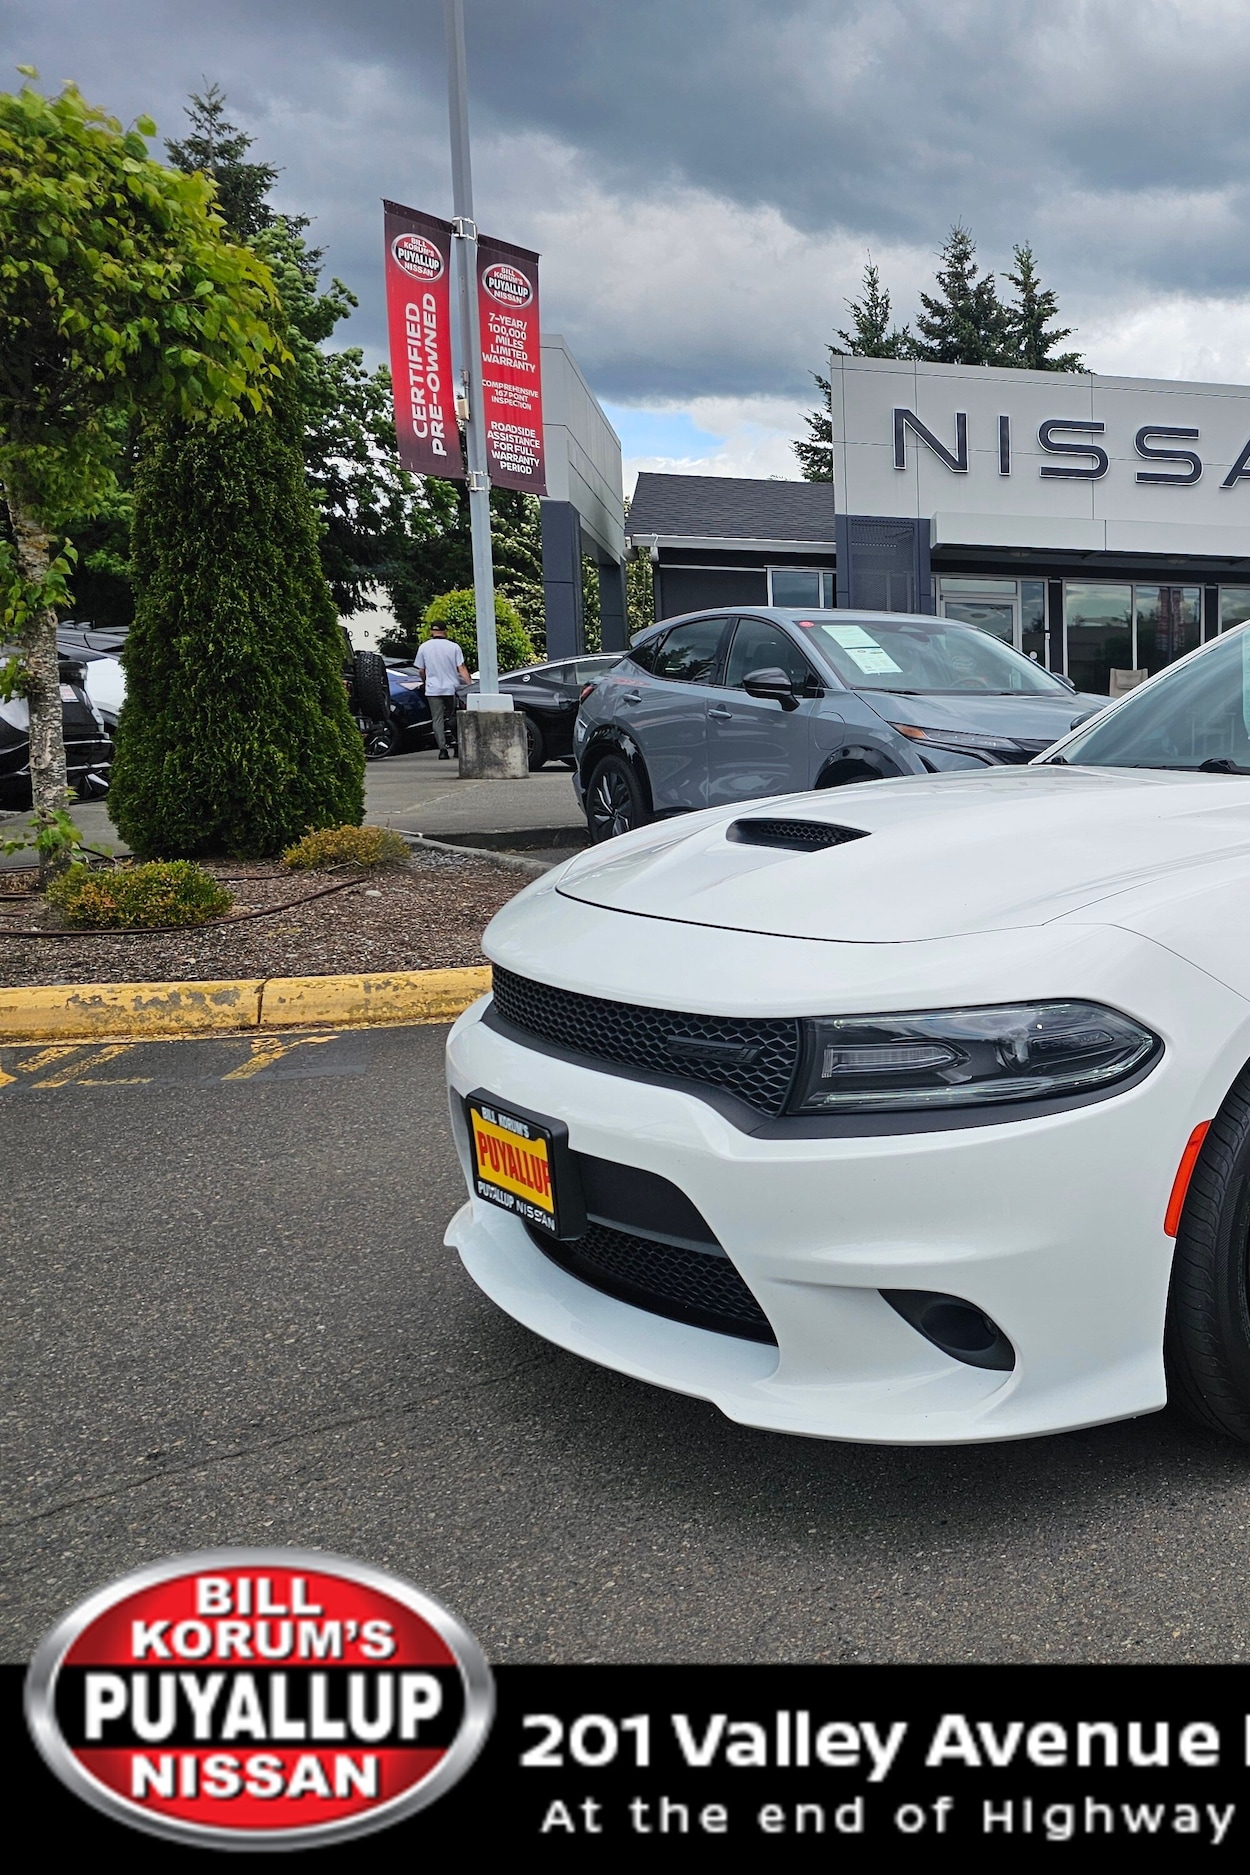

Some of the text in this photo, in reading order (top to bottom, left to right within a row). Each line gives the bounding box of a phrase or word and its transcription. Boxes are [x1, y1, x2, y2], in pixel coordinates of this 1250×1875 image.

[404, 241, 435, 257] KORUM'S
[411, 237, 427, 248] BILL
[398, 247, 440, 270] PUYALLUP
[404, 261, 433, 278] NISSAN
[494, 271, 524, 285] KORUM'S
[501, 267, 515, 277] BILL
[489, 277, 528, 297] PUYALLUP
[494, 290, 522, 304] NISSAN
[489, 312, 527, 331] 7-YEAR/
[488, 323, 527, 341] 100,000
[495, 334, 524, 350] MILES
[490, 343, 528, 361] LIMITED
[405, 302, 428, 439] CERTIFIED
[482, 352, 536, 373] WARRANTY
[422, 292, 447, 457] PRE-OWNED
[481, 379, 539, 398] COMPREHENSIVE
[508, 392, 529, 402] POINT
[491, 395, 532, 411] INSPECTION
[491, 421, 536, 438] ROADSIDE
[487, 431, 541, 448] ASSISTANCE
[493, 441, 535, 457] FOR FULL
[491, 450, 540, 467] WARRANTY
[500, 461, 532, 474] PERIOD
[481, 1107, 530, 1138] BILL KORUM'S
[477, 1181, 556, 1231] PUYALLUP NISSAN
